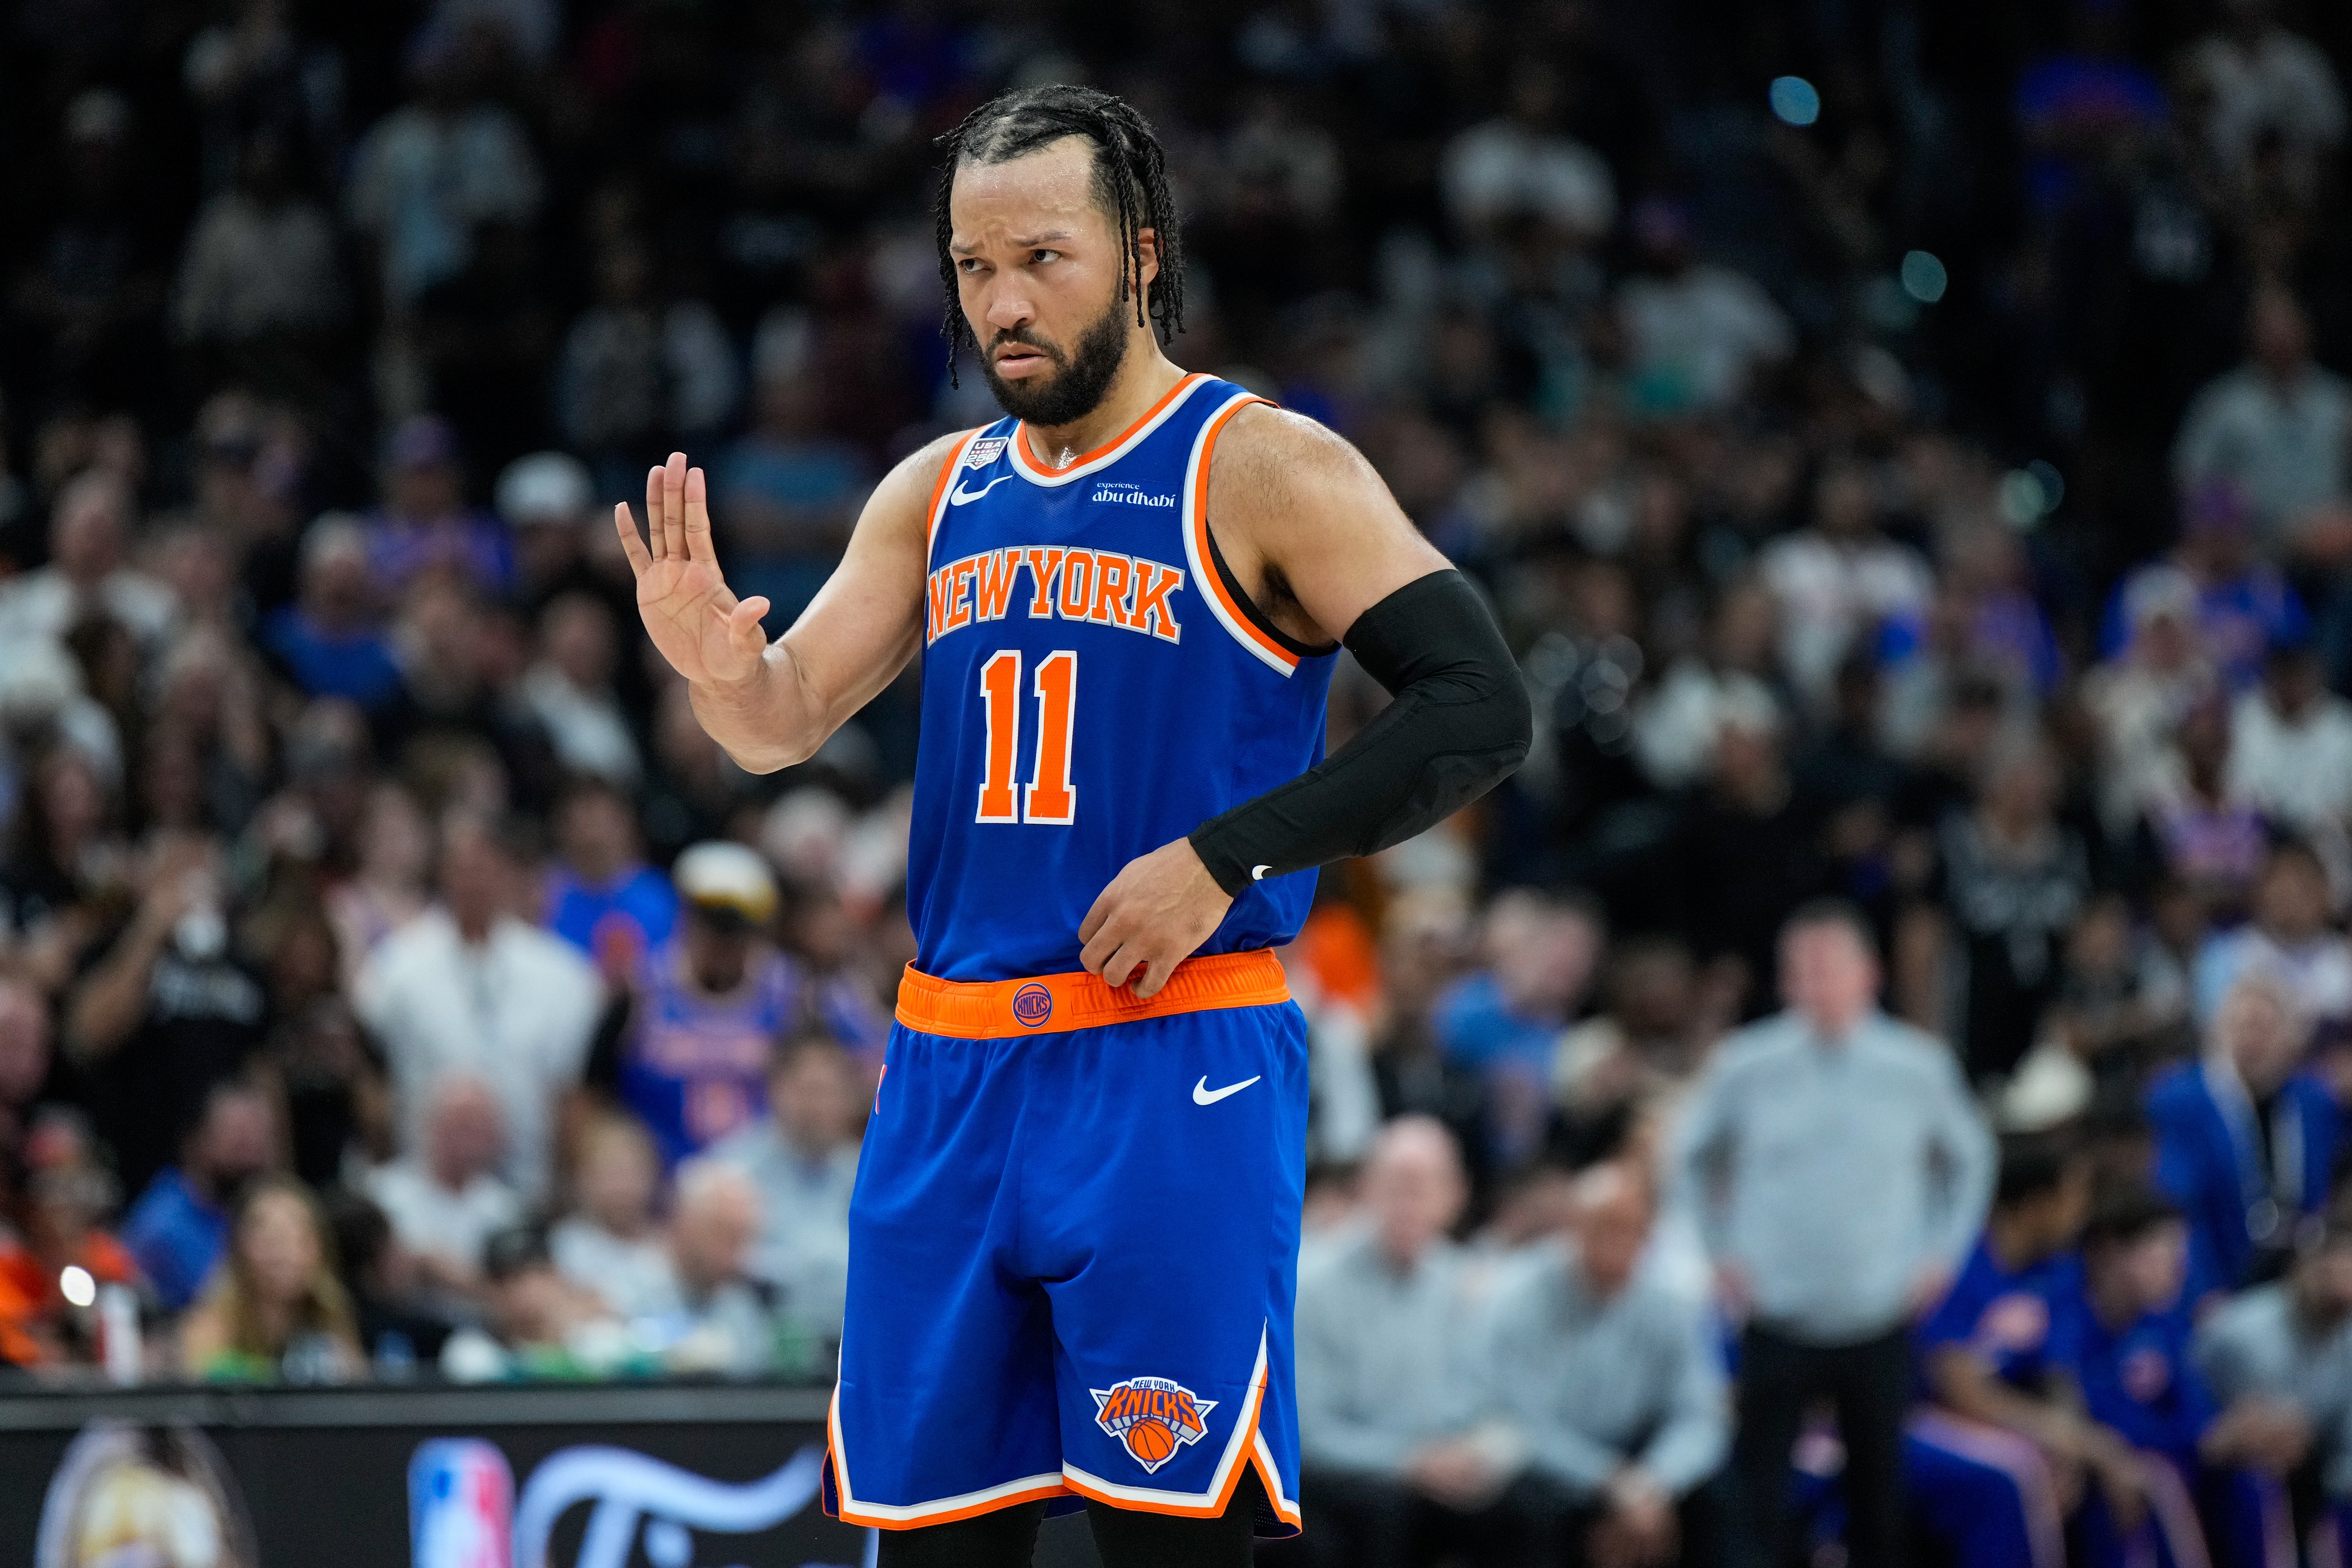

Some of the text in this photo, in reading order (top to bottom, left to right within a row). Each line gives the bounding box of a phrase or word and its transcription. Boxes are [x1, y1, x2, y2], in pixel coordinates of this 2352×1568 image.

[974, 441, 1001, 449] USA
[965, 452, 998, 463] 250
[1092, 489, 1124, 502] abu
[927, 545, 1185, 649] NEW YORK
[975, 649, 1077, 825] 11
[1017, 995, 1048, 1015] KNICKS
[1132, 1379, 1176, 1393] NEW YORK
[1099, 1385, 1203, 1433] KNICKS
